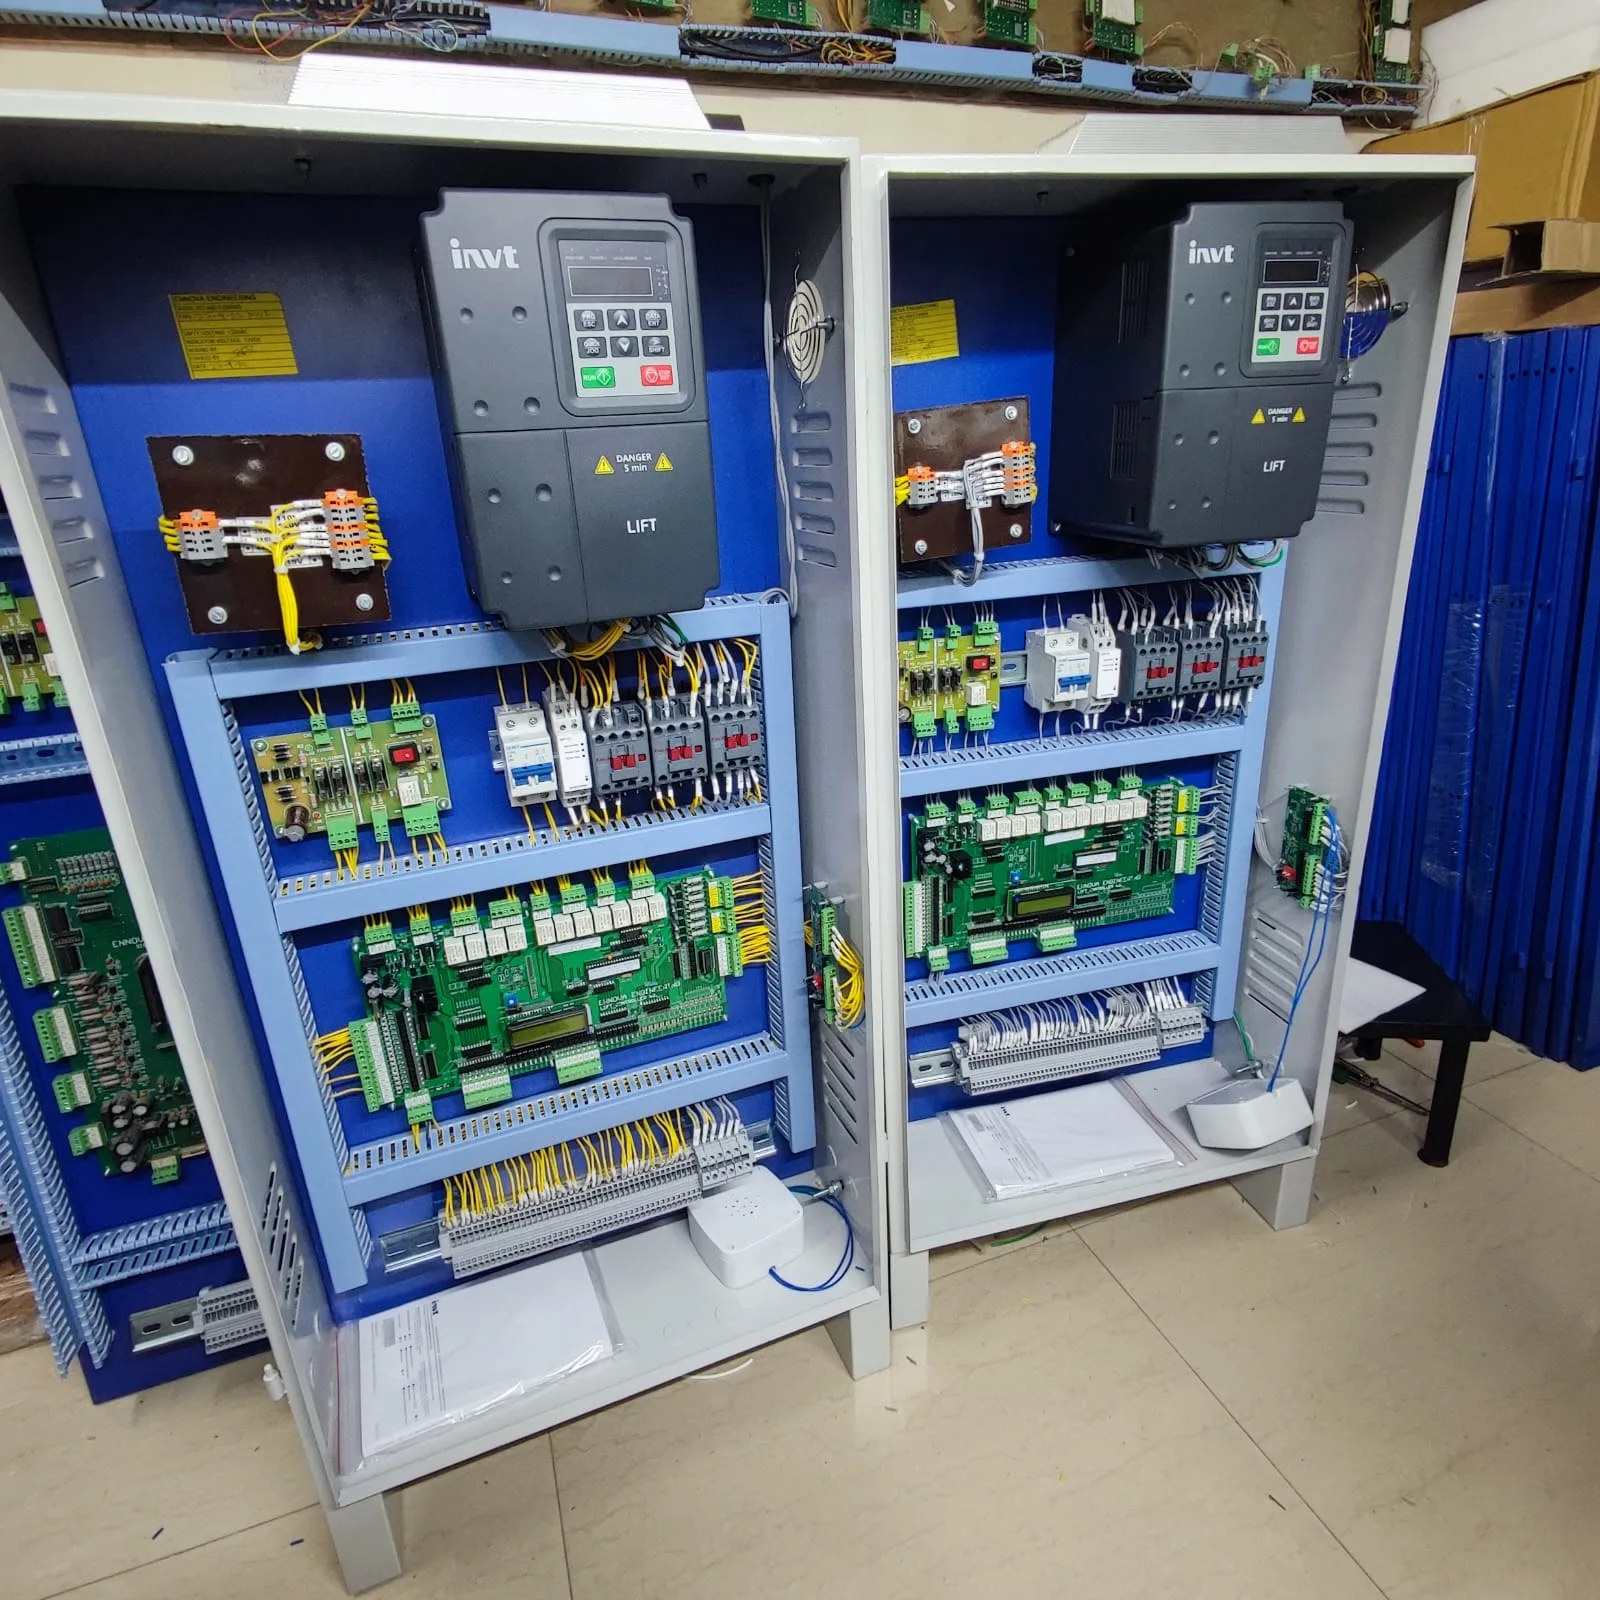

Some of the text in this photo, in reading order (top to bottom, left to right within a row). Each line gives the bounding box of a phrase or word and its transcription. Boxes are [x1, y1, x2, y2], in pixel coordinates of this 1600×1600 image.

[450, 238, 519, 268] invt
[1189, 240, 1235, 264] invt
[1267, 407, 1293, 415] DANGER
[616, 453, 652, 463] DANGER
[624, 463, 648, 473] 5 min
[1263, 460, 1286, 472] LIFT
[627, 518, 657, 534] LIFT
